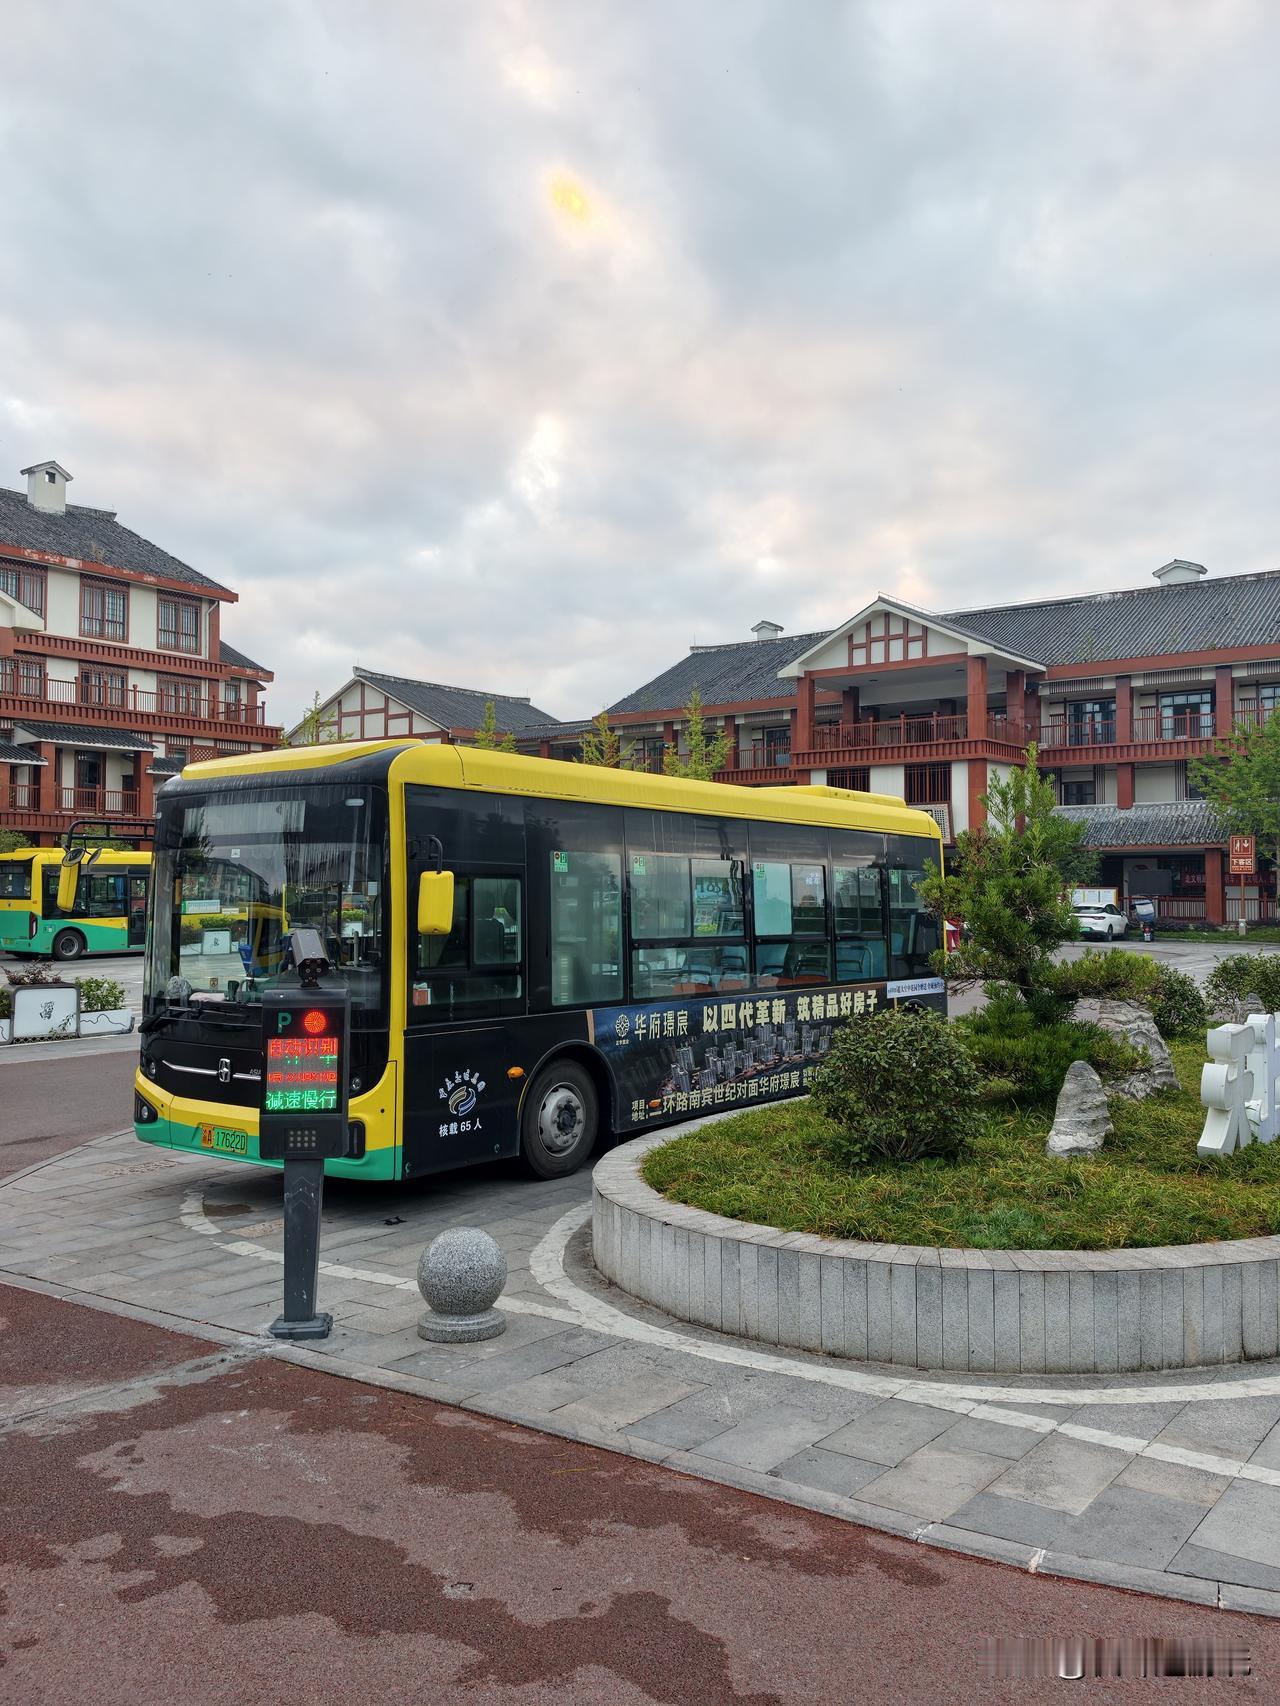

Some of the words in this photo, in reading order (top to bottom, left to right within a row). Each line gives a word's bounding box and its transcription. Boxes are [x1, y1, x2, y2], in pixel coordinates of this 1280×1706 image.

[1232, 858, 1252, 866] 下客区
[702, 998, 786, 1033] 以四代革新
[797, 989, 878, 1022] 筑精品好房子
[277, 1012, 292, 1033] P
[634, 1009, 688, 1041] 华府璟宸
[270, 1038, 338, 1057] 自动识别
[266, 1090, 336, 1110] 减速慢行
[439, 1122, 458, 1138] 核载
[460, 1120, 471, 1132] 65
[474, 1117, 482, 1131] 人
